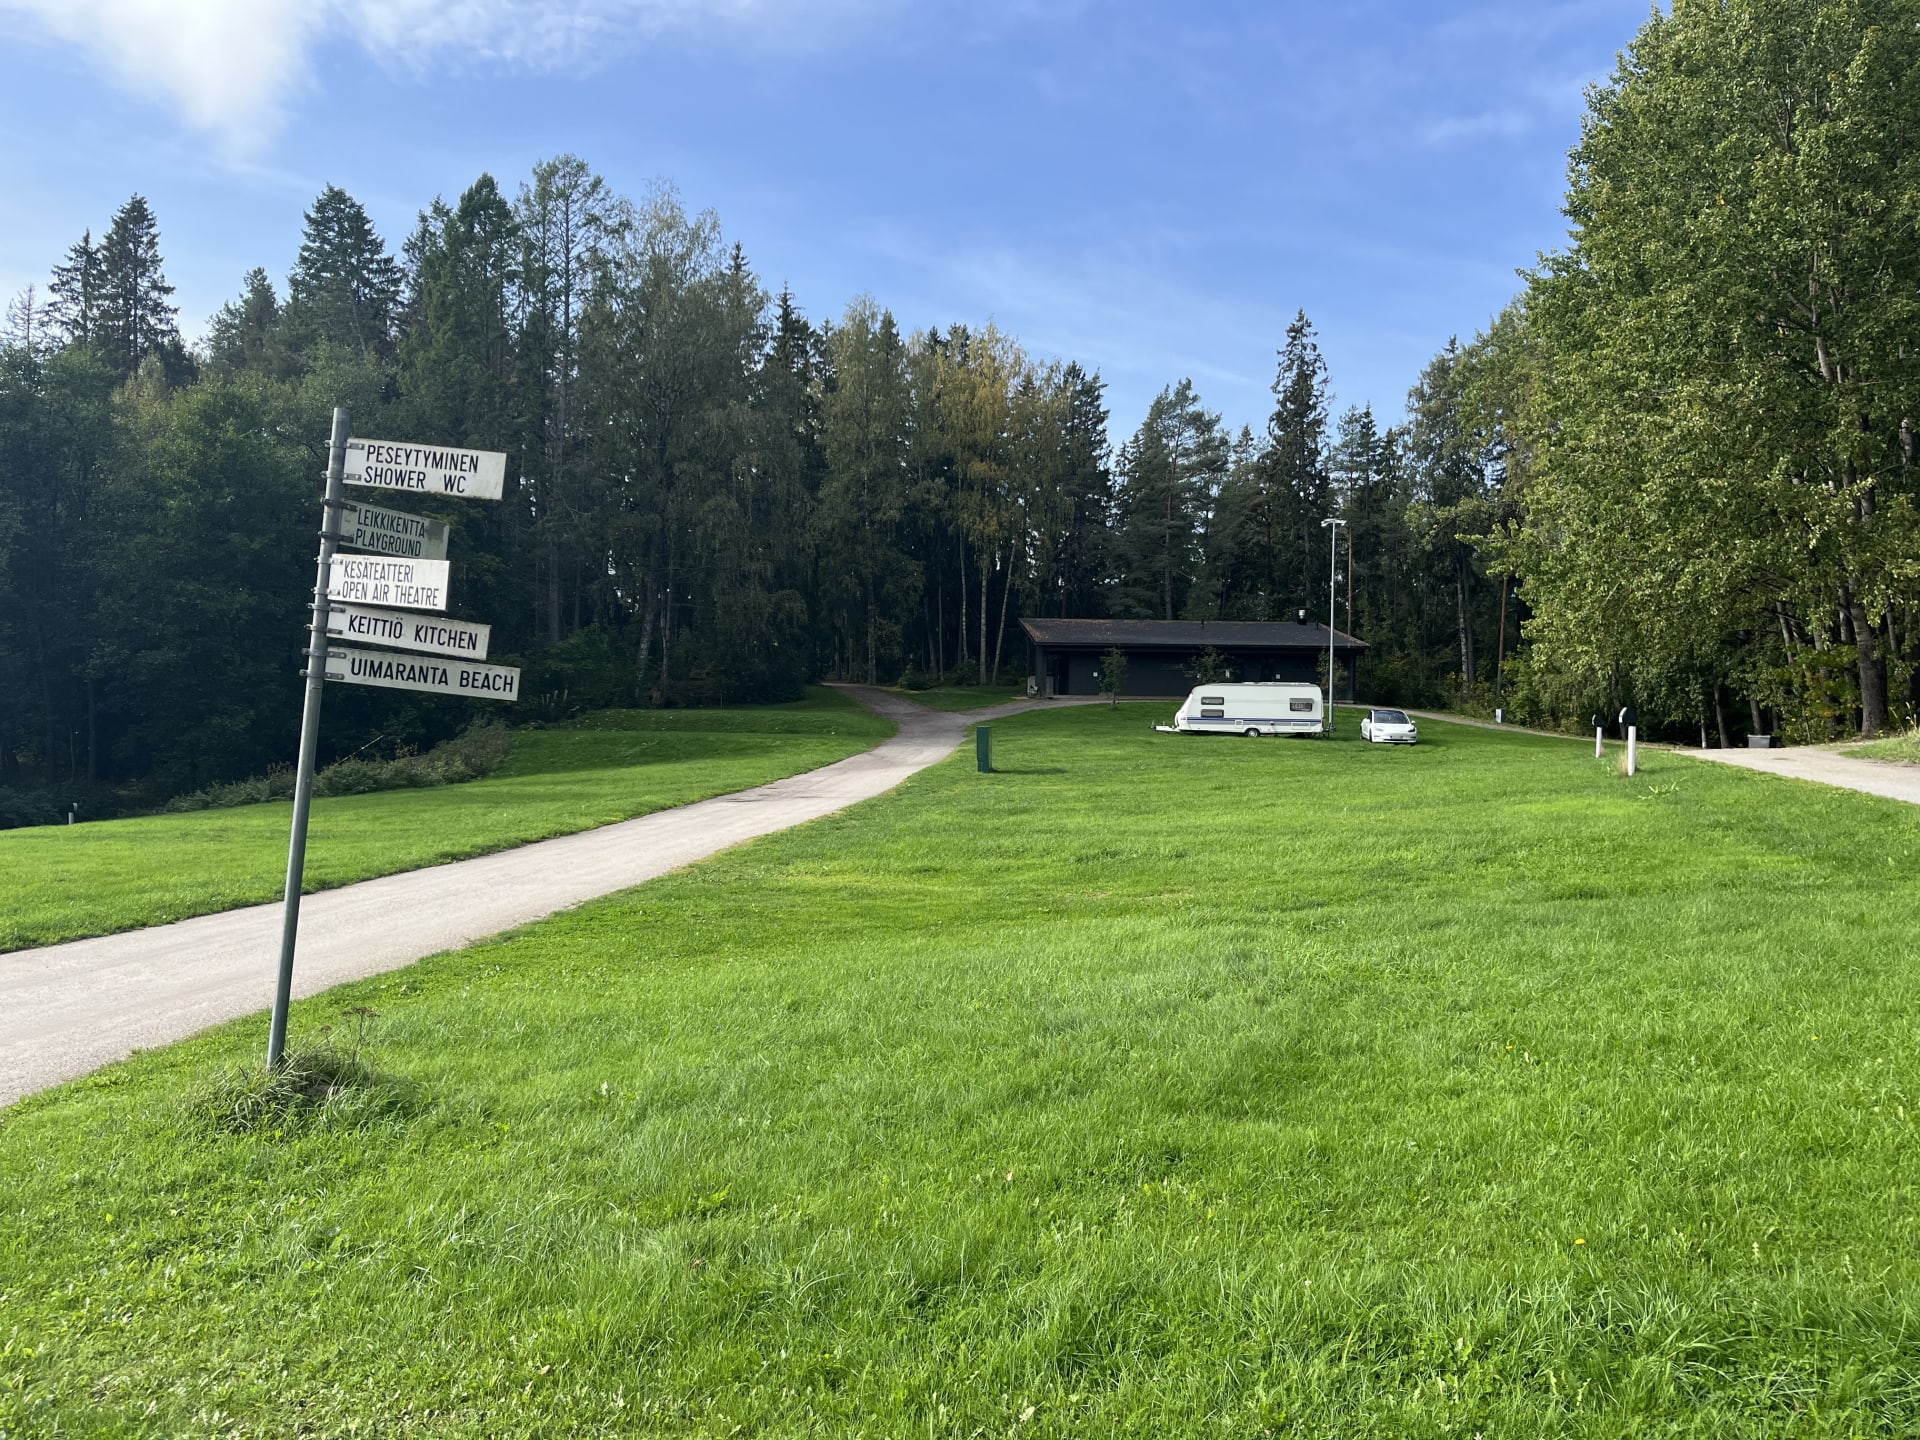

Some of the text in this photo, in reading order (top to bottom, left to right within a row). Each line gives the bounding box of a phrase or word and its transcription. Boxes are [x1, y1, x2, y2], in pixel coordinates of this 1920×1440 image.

[366, 444, 479, 474] PESEYTYMINEN
[364, 466, 467, 494] SHOWER WC
[357, 508, 425, 538] LEIKKIKENTTÄ
[355, 529, 422, 557] PLAYGROUND
[343, 558, 414, 583] KESÄTEATTERI
[342, 582, 439, 607] OPEN AIR THEATRE
[348, 614, 478, 651] KEITTIÖ KITCHEN
[351, 657, 514, 693] UIMARANTA BEACH
